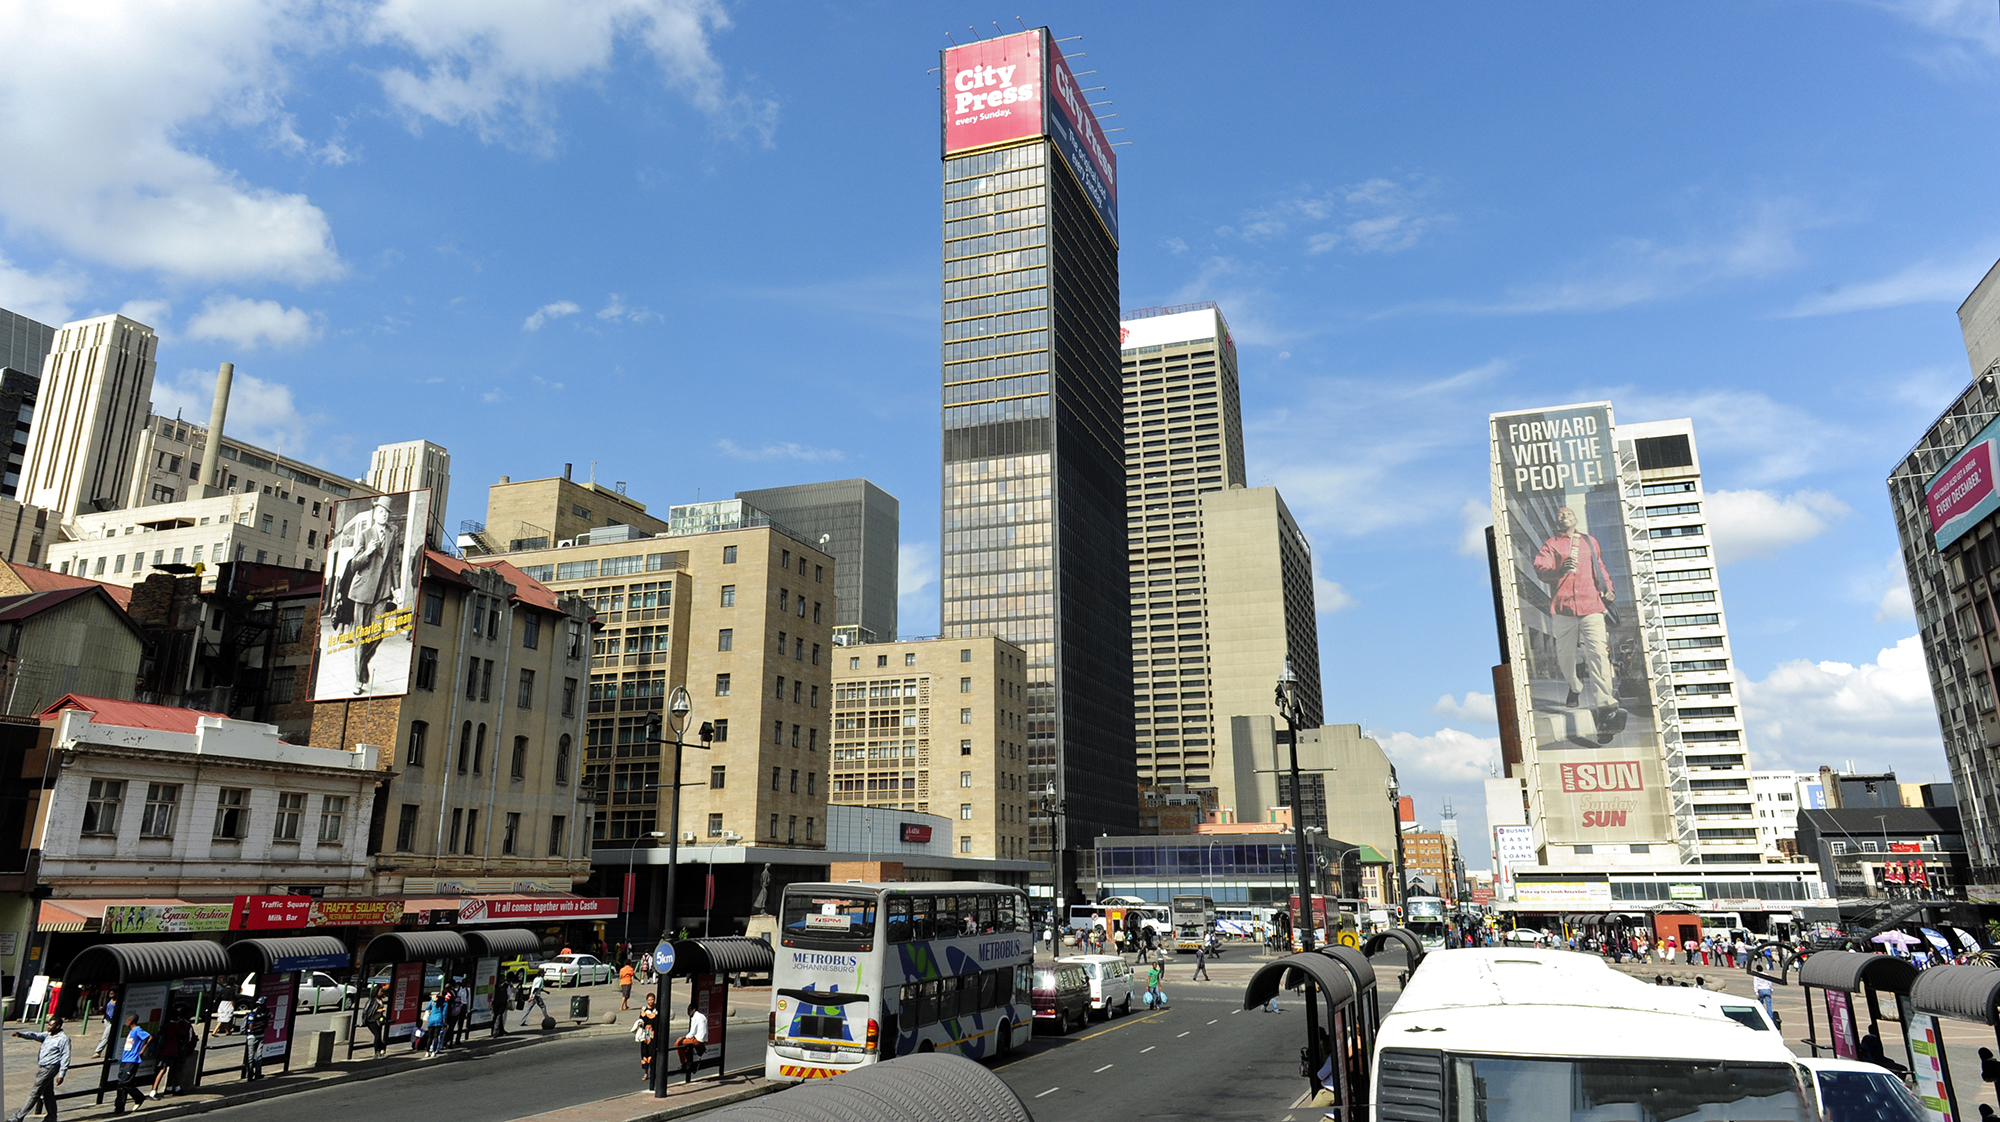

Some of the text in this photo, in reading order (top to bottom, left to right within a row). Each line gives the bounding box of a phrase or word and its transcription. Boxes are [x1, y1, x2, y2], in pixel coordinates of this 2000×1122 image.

[955, 64, 1016, 91] City
[954, 84, 1033, 114] Press
[955, 108, 1012, 126] every Sunday.
[1055, 64, 1114, 185] City Press
[1068, 128, 1078, 152] The
[1072, 153, 1086, 180] every
[1508, 416, 1598, 444] FORWARD
[1511, 437, 1602, 466] WITH THE
[1515, 460, 1604, 492] PEOPLE!
[1936, 495, 1952, 517] EVERY
[328, 631, 354, 647] Herman
[355, 621, 382, 639] Charles
[384, 613, 412, 630] Bosman
[1563, 764, 1641, 791] DAILY SUN
[1580, 794, 1638, 812] Sunday
[1582, 811, 1627, 828] SUN
[162, 907, 190, 923] Eyasu
[192, 907, 229, 920] Fashion
[322, 902, 387, 912] TRAFFIC SQUARE
[460, 901, 484, 920] CASTLE
[495, 902, 501, 912] It
[502, 902, 511, 912] all
[512, 903, 531, 912] comes
[533, 902, 559, 914] together
[560, 901, 573, 911] with
[580, 900, 597, 910] Castle
[656, 951, 673, 964] 5km
[792, 953, 856, 966] METROBUS
[978, 939, 1020, 962] METROBUS
[792, 964, 855, 973] JOHANNESBURG
